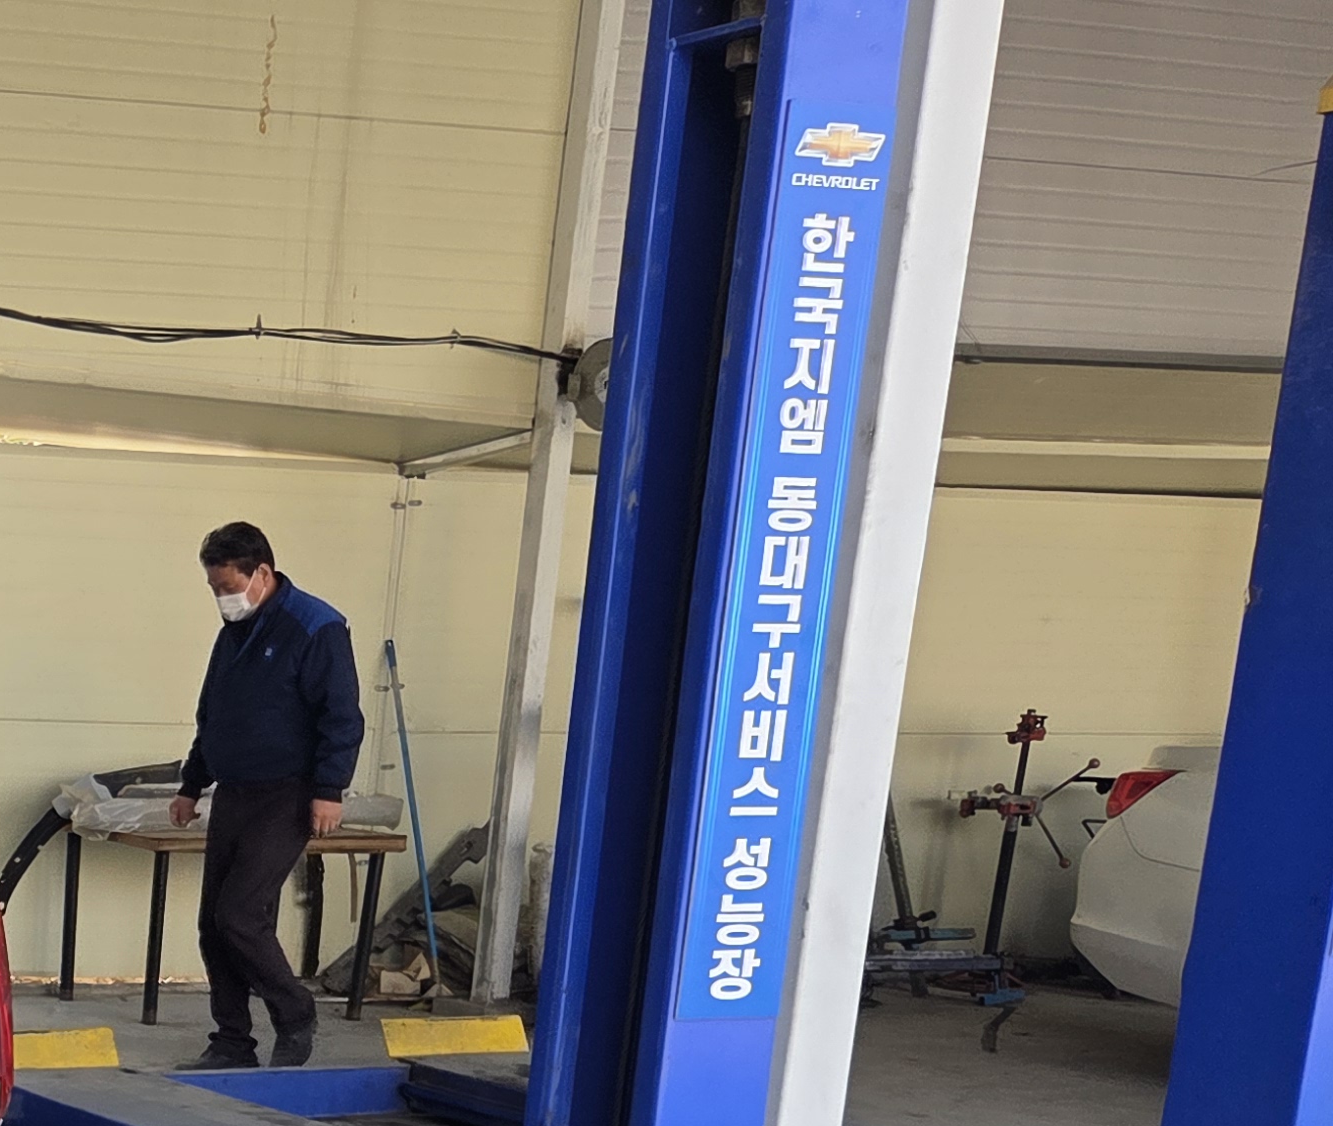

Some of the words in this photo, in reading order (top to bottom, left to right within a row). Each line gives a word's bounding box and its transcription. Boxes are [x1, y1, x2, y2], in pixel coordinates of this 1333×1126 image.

[791, 173, 880, 191] CHEVROLET
[779, 213, 855, 454] 한국지엠
[729, 476, 819, 817] 동대구서비스
[709, 837, 773, 1001] 성능장
